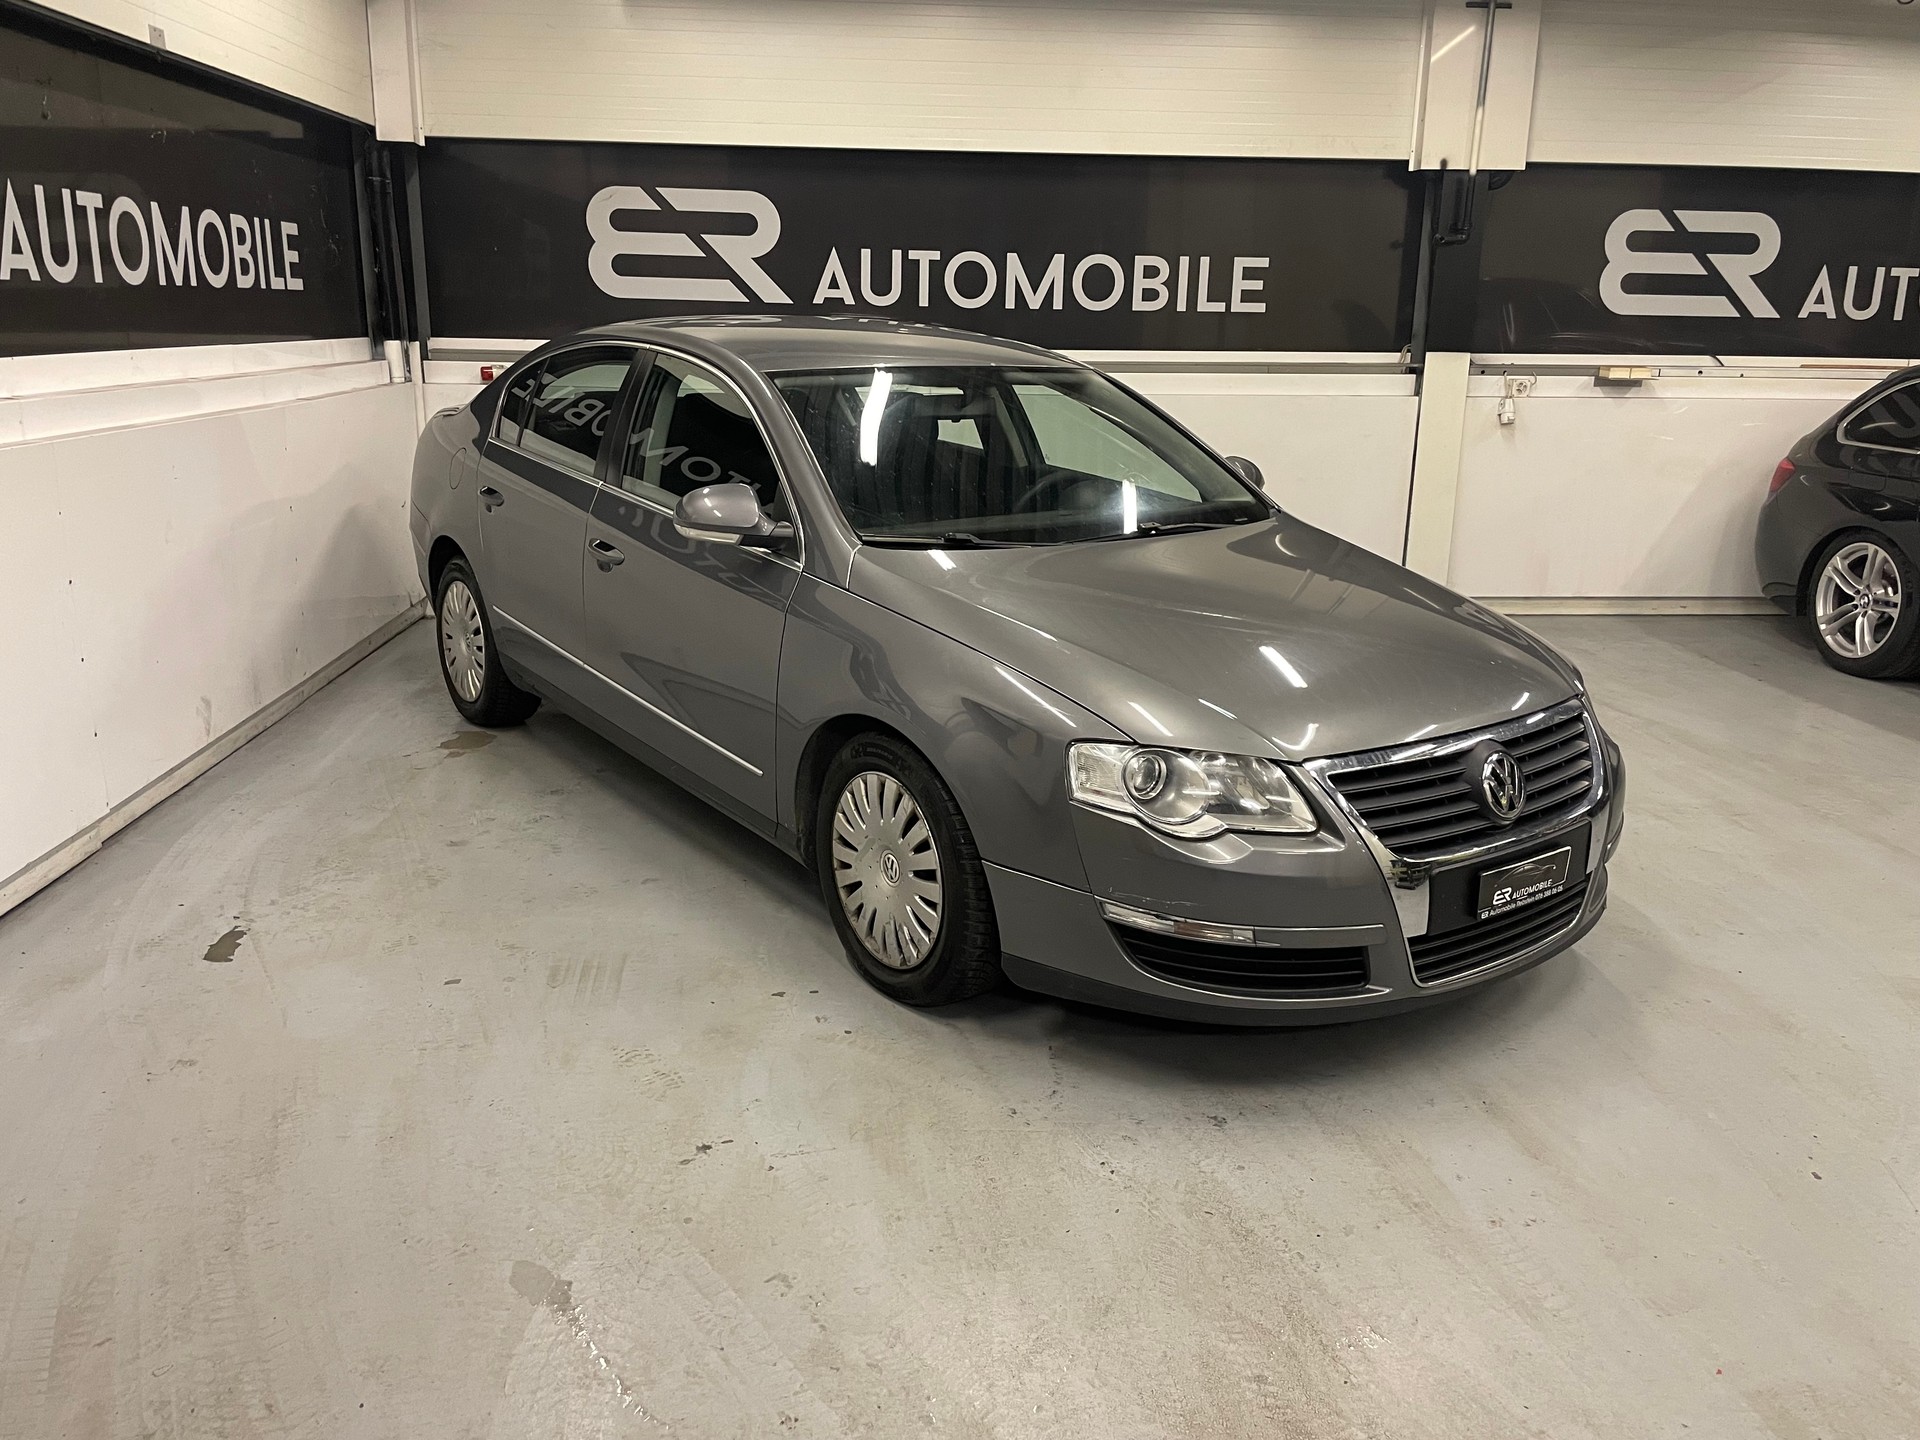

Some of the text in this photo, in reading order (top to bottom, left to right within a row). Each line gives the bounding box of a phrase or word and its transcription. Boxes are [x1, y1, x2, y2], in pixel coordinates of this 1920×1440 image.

[0, 178, 304, 291] AUTOMOBILE
[812, 246, 1270, 313] AUTOMOBILE
[1797, 264, 1920, 321] AUT
[1512, 879, 1553, 900] AUTOMOBILE
